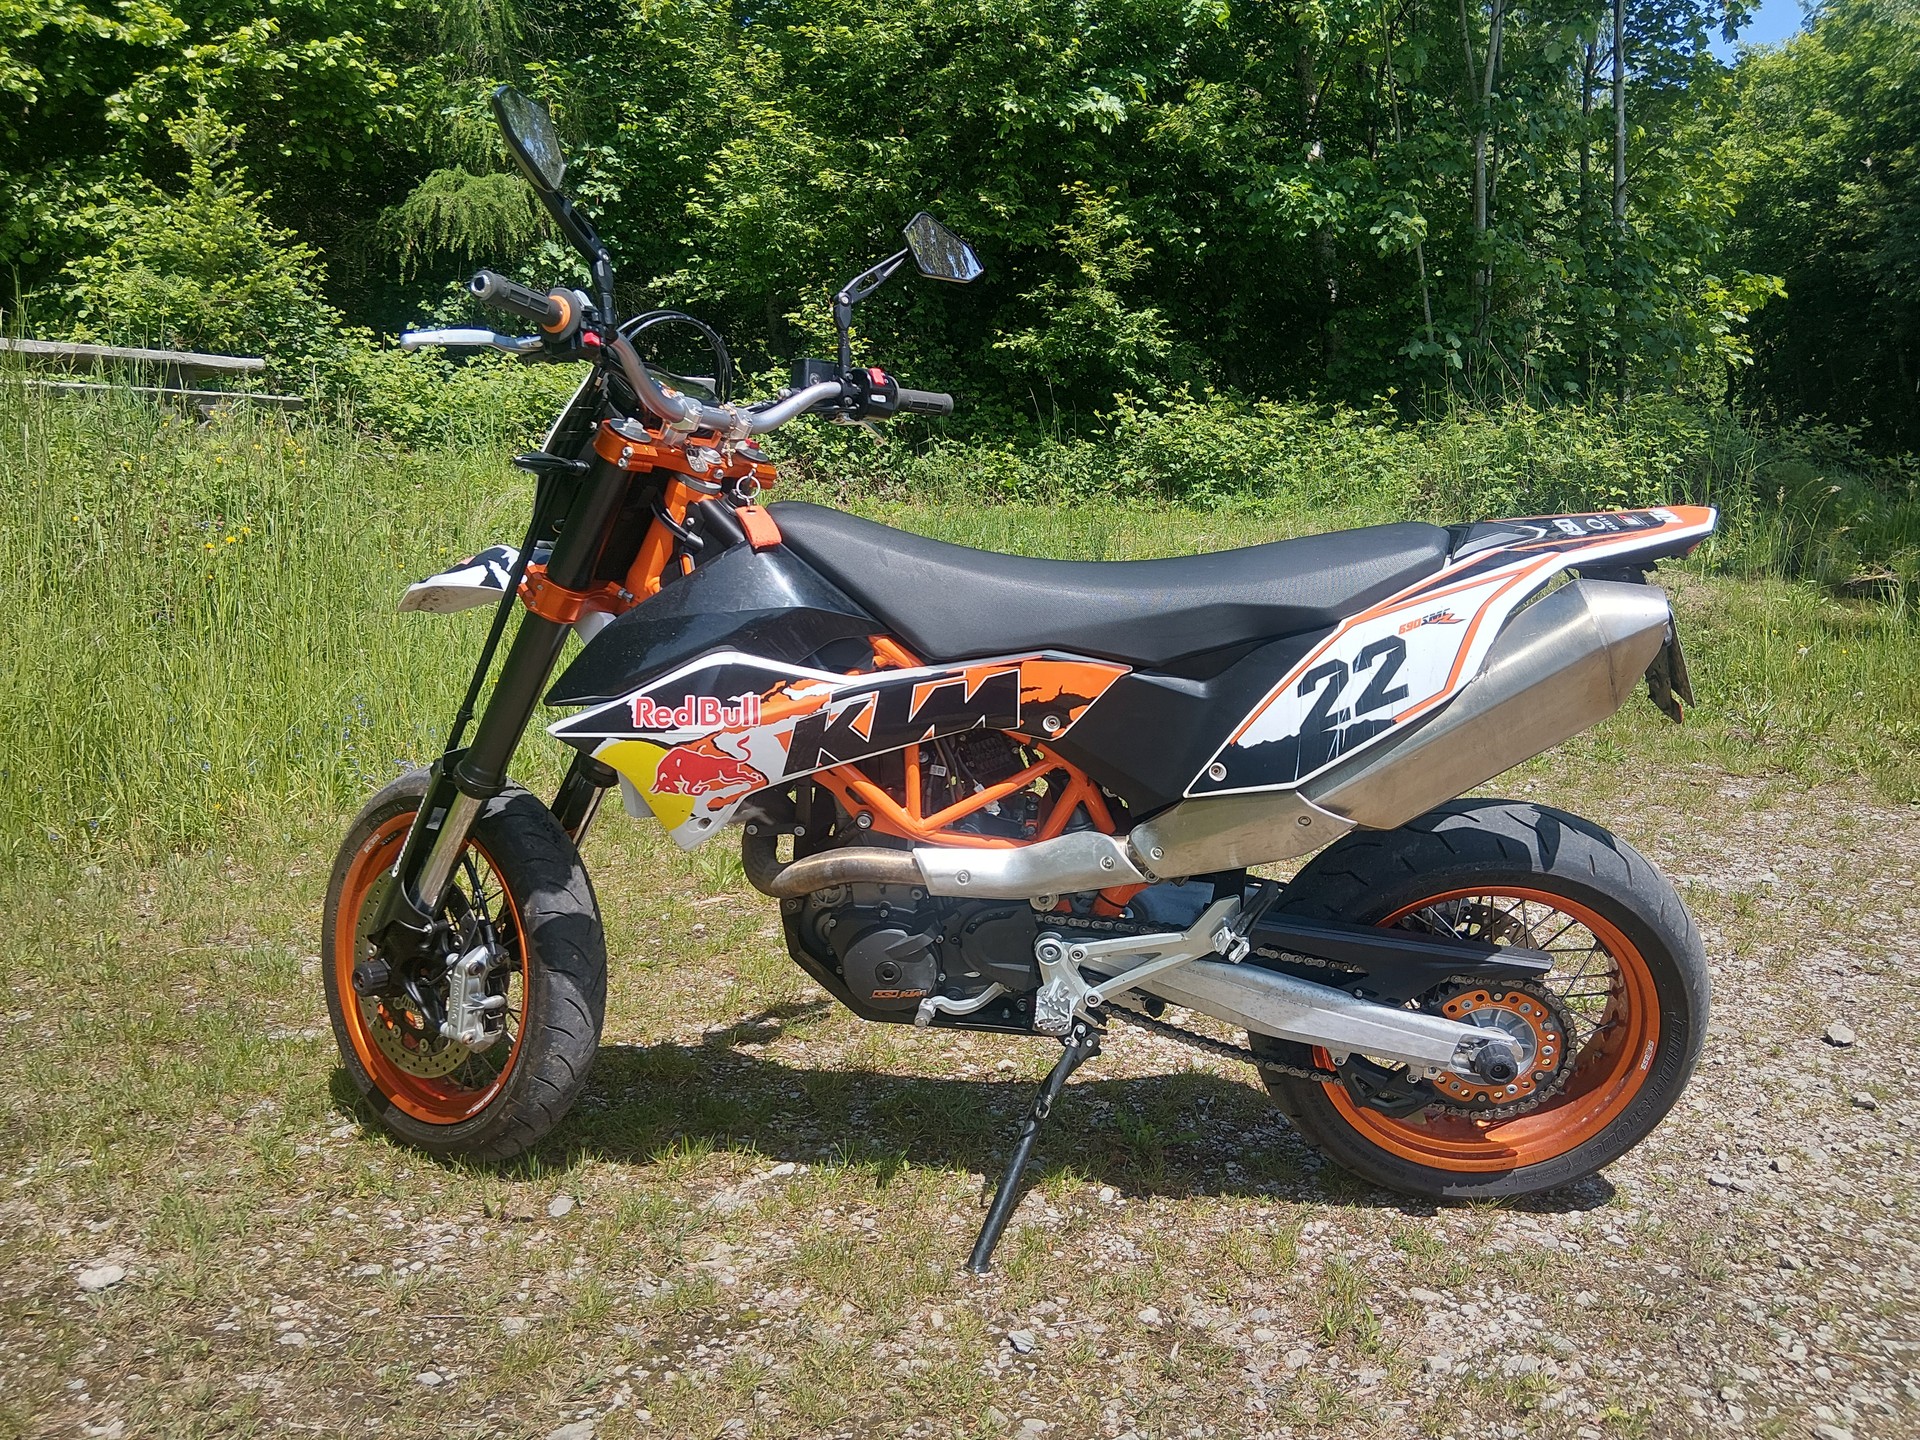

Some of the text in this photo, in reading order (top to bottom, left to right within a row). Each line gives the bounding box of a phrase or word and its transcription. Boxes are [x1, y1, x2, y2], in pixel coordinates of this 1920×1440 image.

[634, 695, 760, 728] Red Bull
[782, 669, 1020, 777] KTM
[1297, 634, 1410, 742] 22
